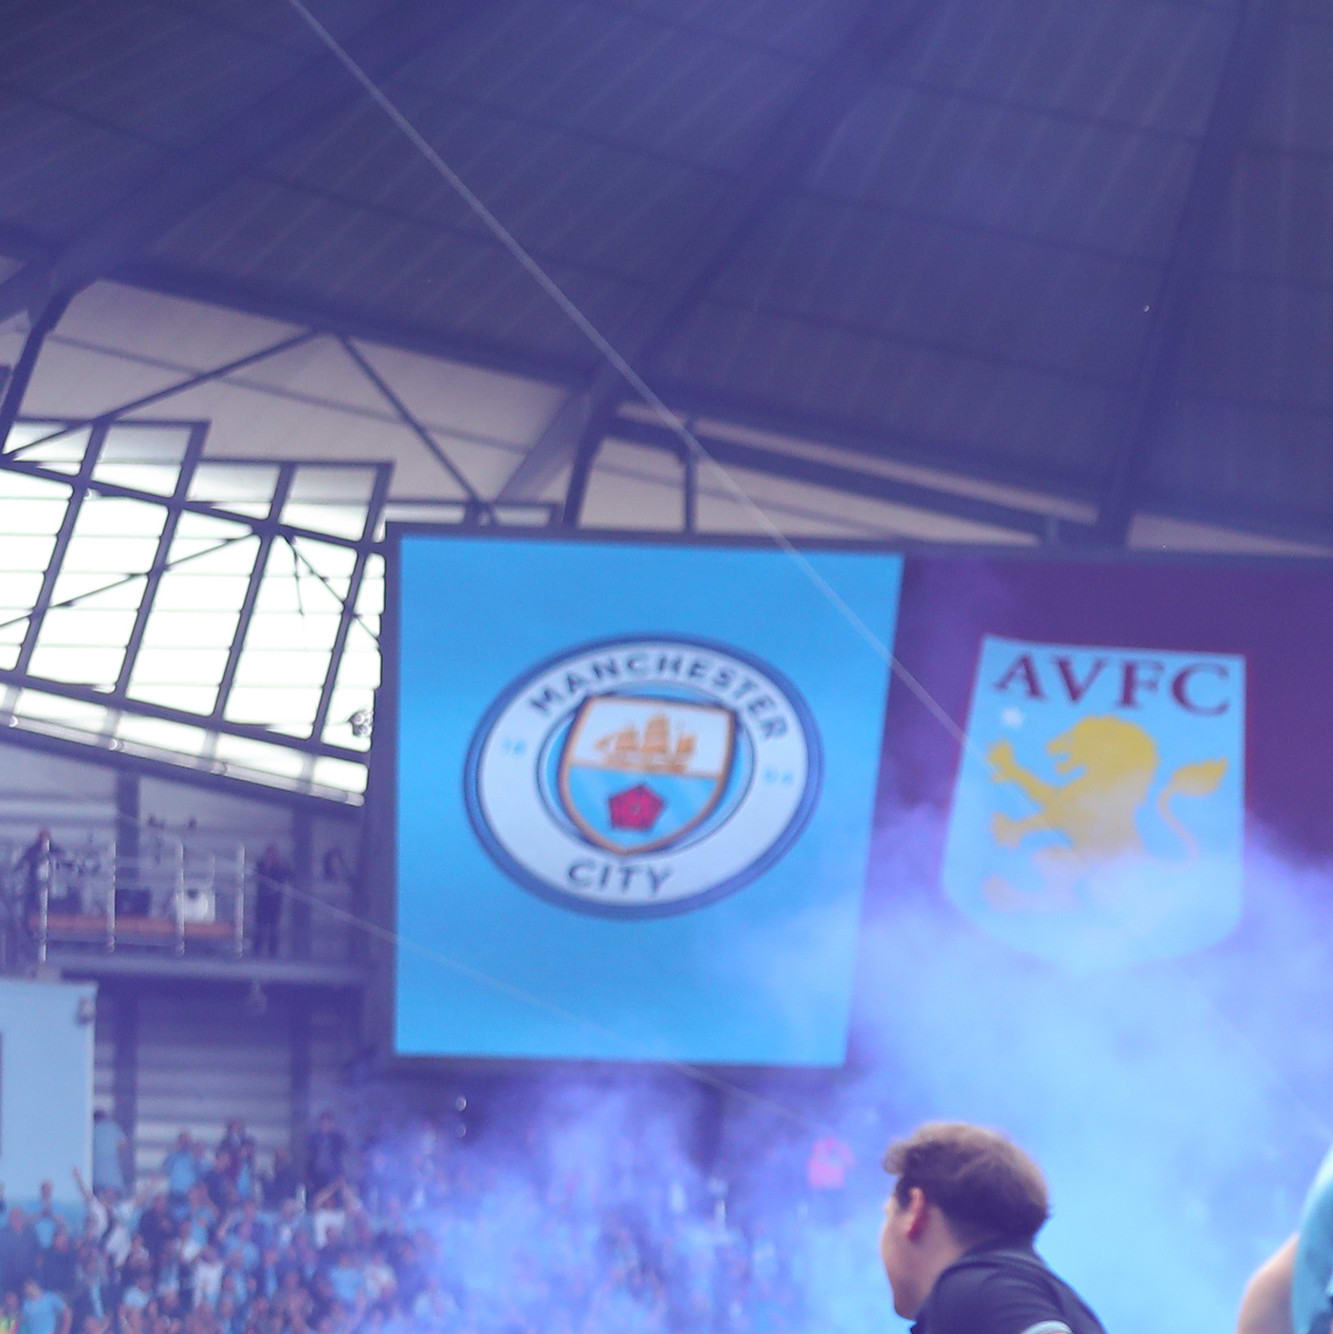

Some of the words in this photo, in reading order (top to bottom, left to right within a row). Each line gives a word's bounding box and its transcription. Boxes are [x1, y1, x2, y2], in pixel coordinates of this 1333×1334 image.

[530, 653, 789, 740] MANCHESTER
[992, 652, 1231, 717] AVFC
[568, 858, 673, 895] CITY
